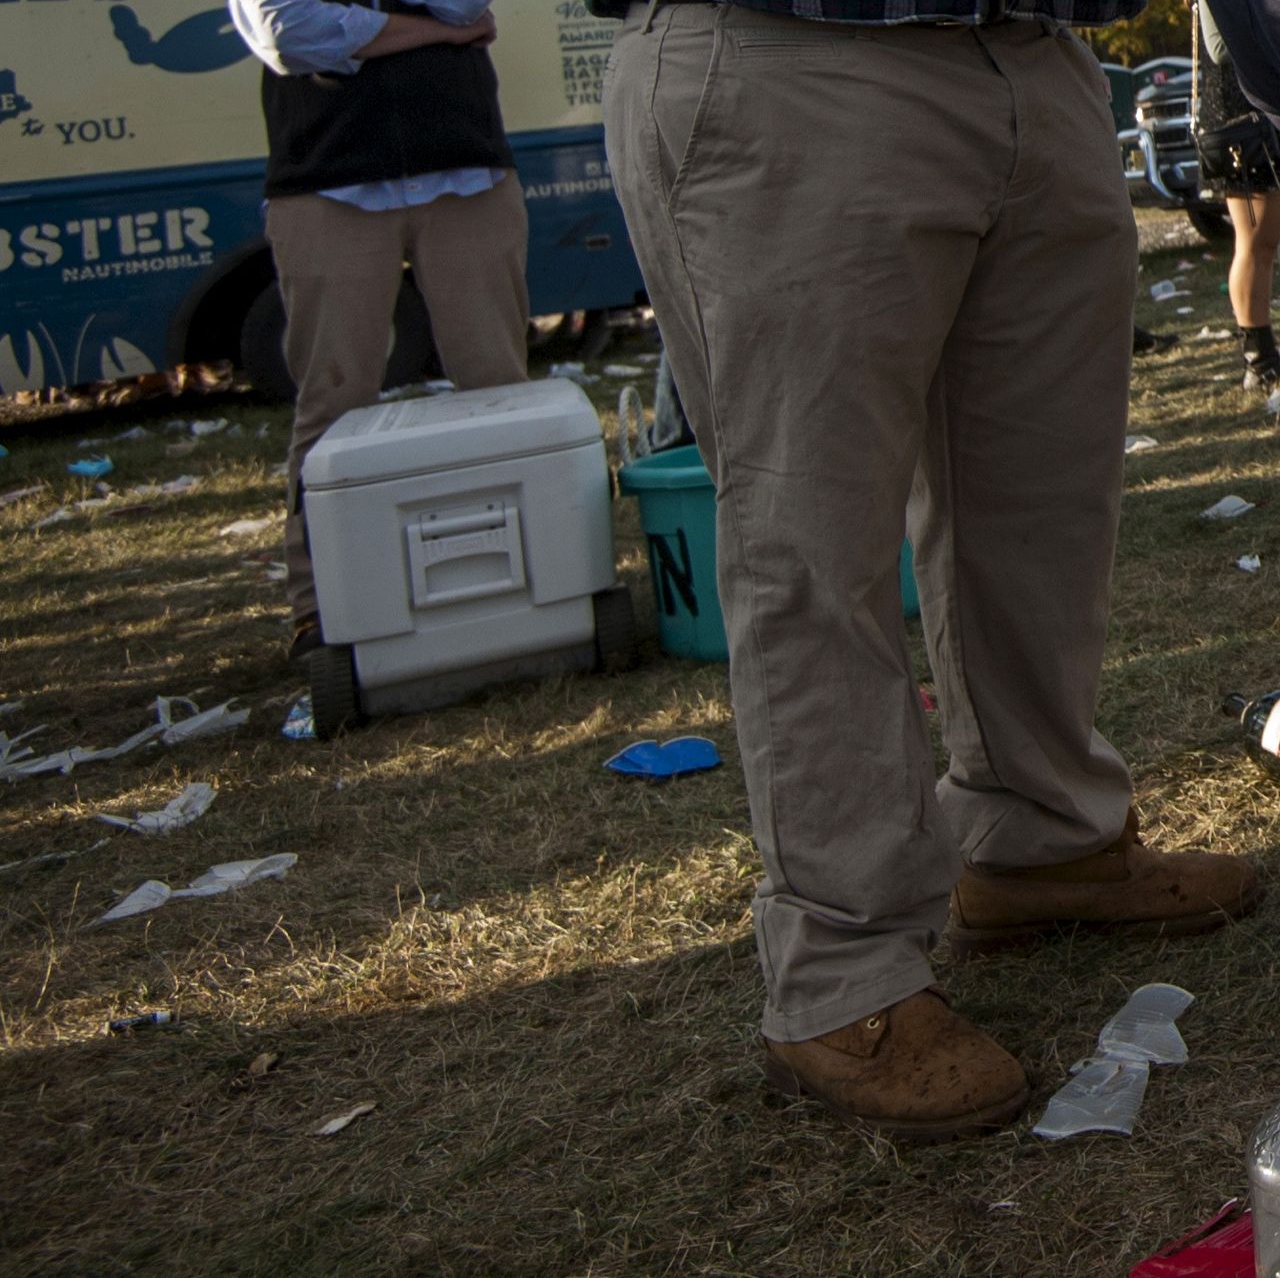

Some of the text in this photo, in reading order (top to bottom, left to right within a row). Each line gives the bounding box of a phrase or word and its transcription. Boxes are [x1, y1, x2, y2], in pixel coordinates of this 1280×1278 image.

[560, 29, 615, 43] AWARD
[58, 117, 136, 145] YOU.
[61, 251, 214, 283] NAUTIMOBILE
